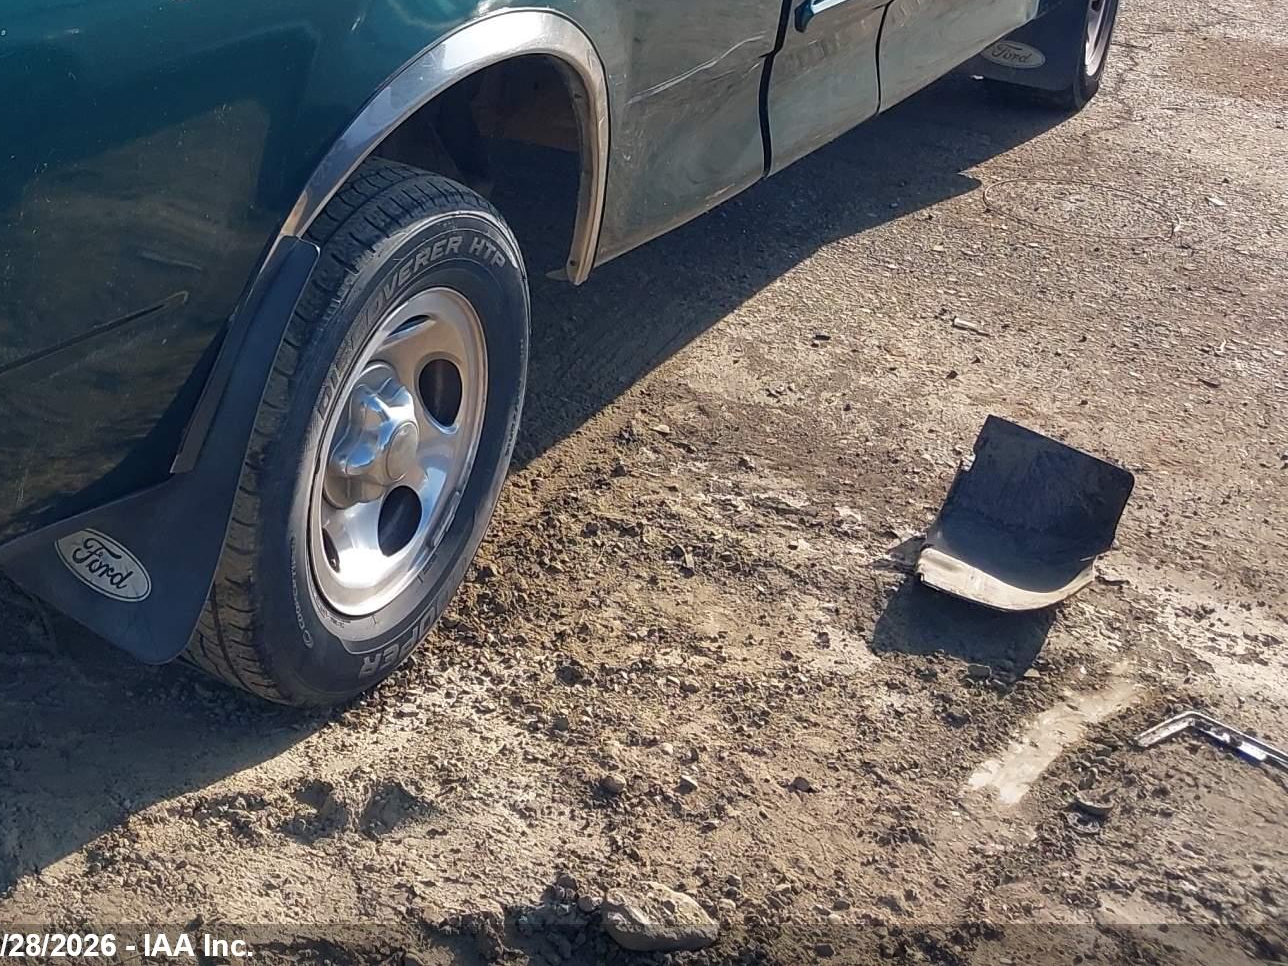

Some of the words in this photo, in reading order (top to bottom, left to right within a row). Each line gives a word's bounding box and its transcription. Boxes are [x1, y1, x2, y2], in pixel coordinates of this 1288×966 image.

[991, 43, 1033, 64] Ford
[469, 236, 506, 268] HTP
[72, 537, 134, 589] Ford
